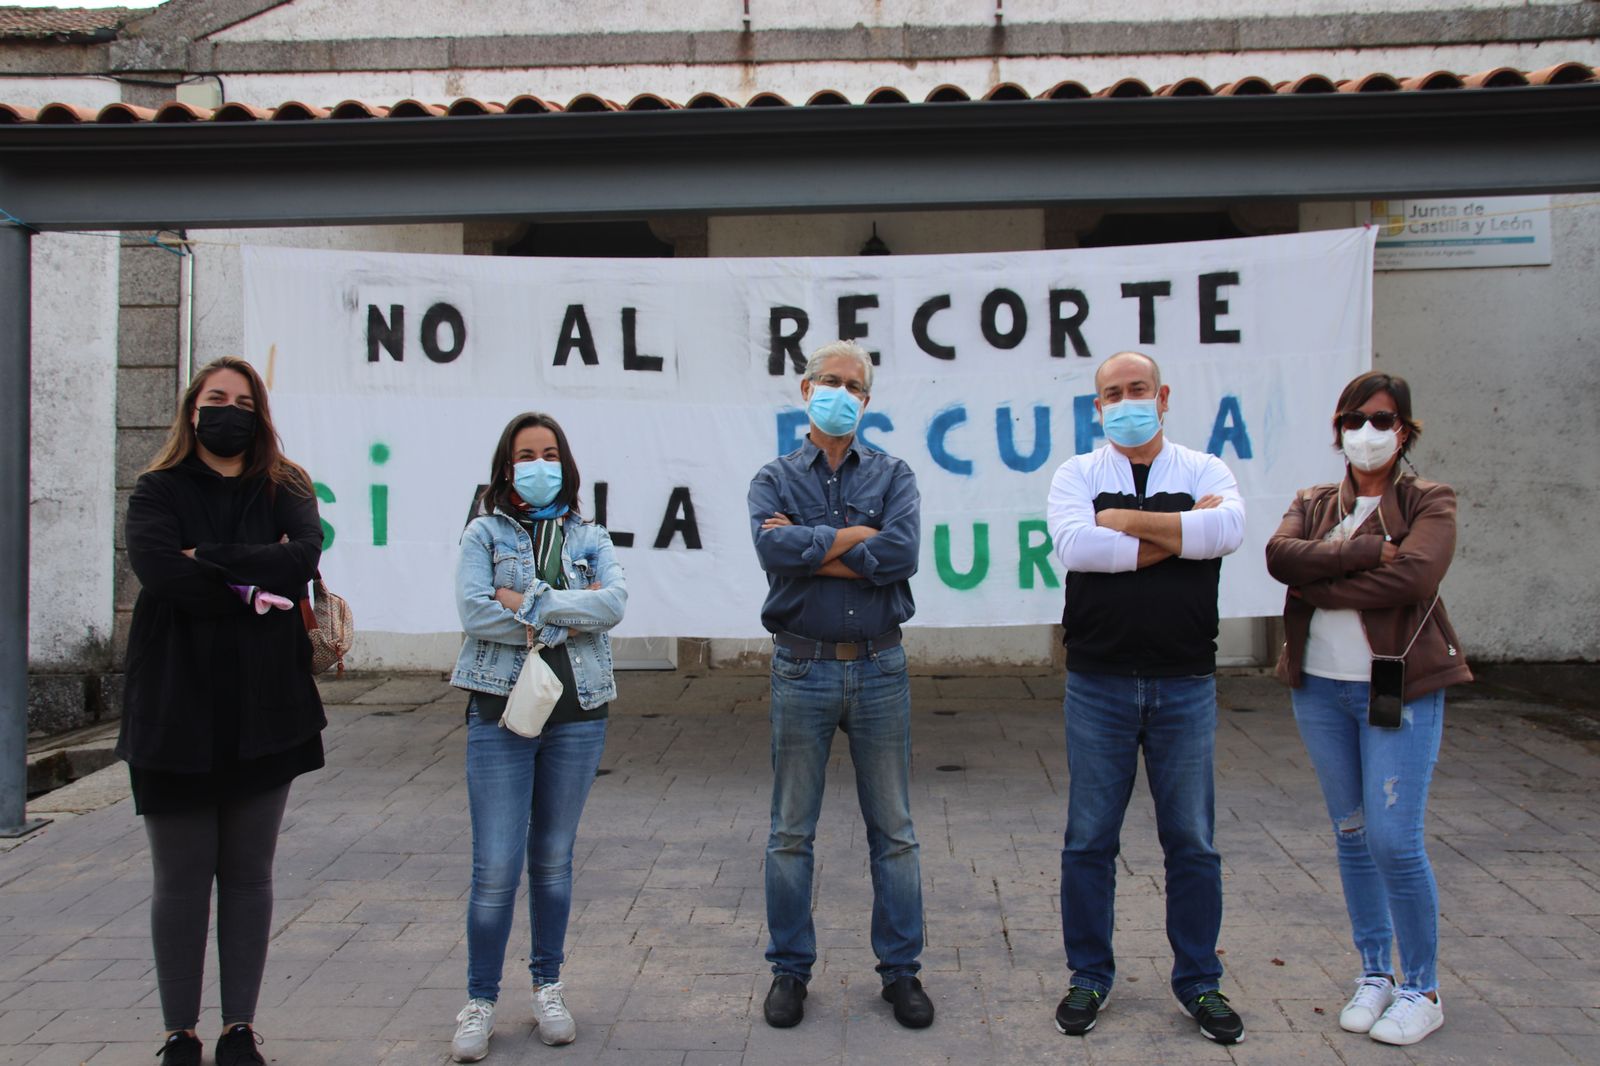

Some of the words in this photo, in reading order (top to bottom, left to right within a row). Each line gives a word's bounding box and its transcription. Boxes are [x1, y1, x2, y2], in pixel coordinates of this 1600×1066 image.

[1408, 204, 1457, 218] Junta
[1463, 203, 1484, 216] de
[1408, 218, 1470, 234] Castilla
[1475, 221, 1486, 235] y
[1490, 216, 1533, 231] León
[367, 302, 467, 363] NO
[552, 304, 664, 371] AL
[768, 271, 1242, 375] RECORTE
[776, 394, 1254, 476] ESCUEA
[594, 482, 702, 549] LA
